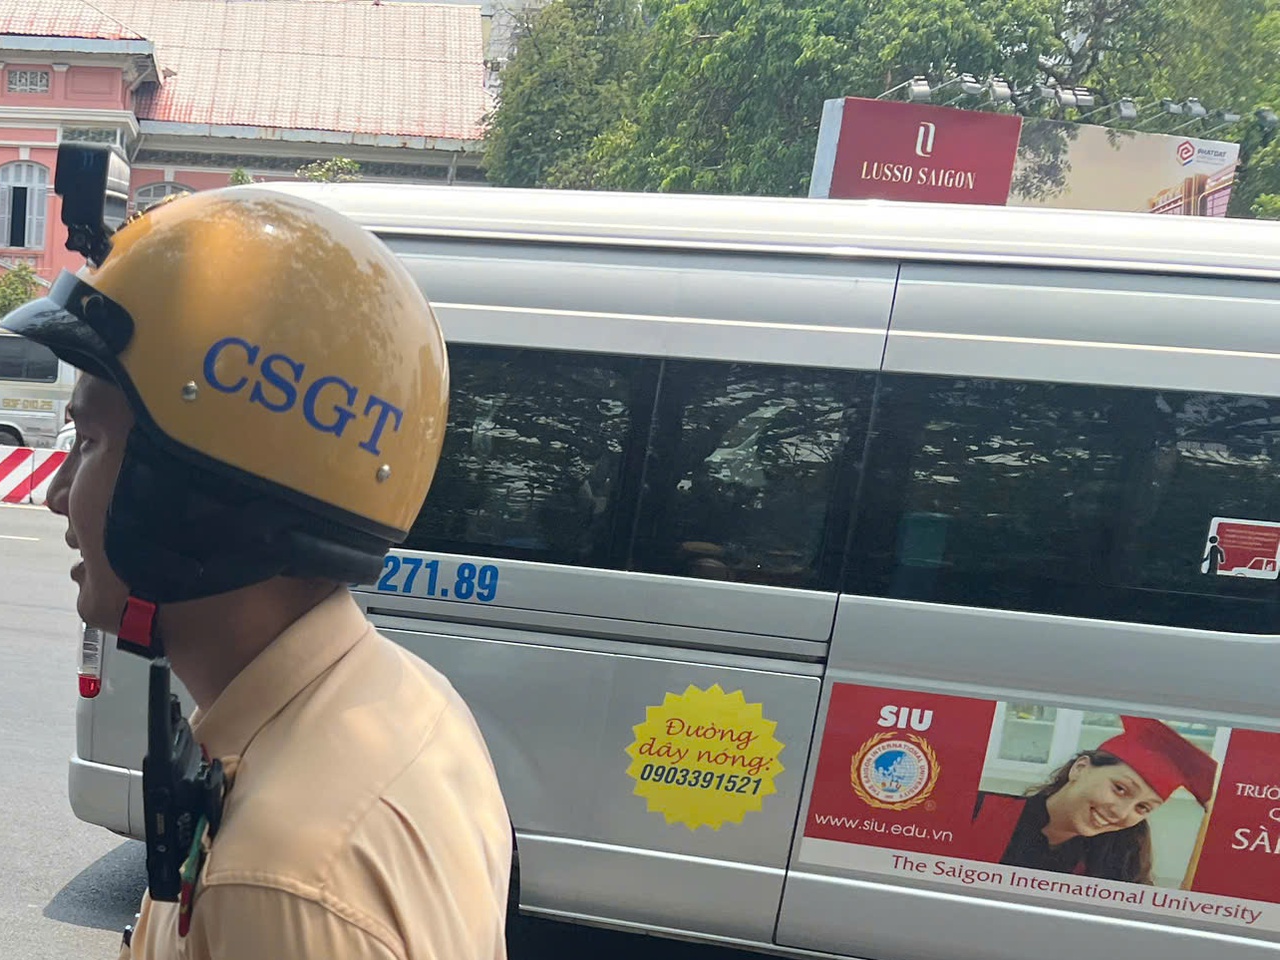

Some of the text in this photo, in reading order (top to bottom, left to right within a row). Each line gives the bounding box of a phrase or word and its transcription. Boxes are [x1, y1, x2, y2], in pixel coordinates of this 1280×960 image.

[861, 161, 976, 189] LUSSO SAIGON
[203, 337, 403, 456] CSGT
[378, 555, 499, 602] 271.89
[666, 718, 760, 750] Đường
[877, 705, 933, 731] SIU
[639, 738, 773, 776] dây nóng:
[640, 763, 762, 795] 0903391521
[815, 813, 953, 842] www.siu.edu.vn
[892, 855, 1263, 925] The Saigon International University
